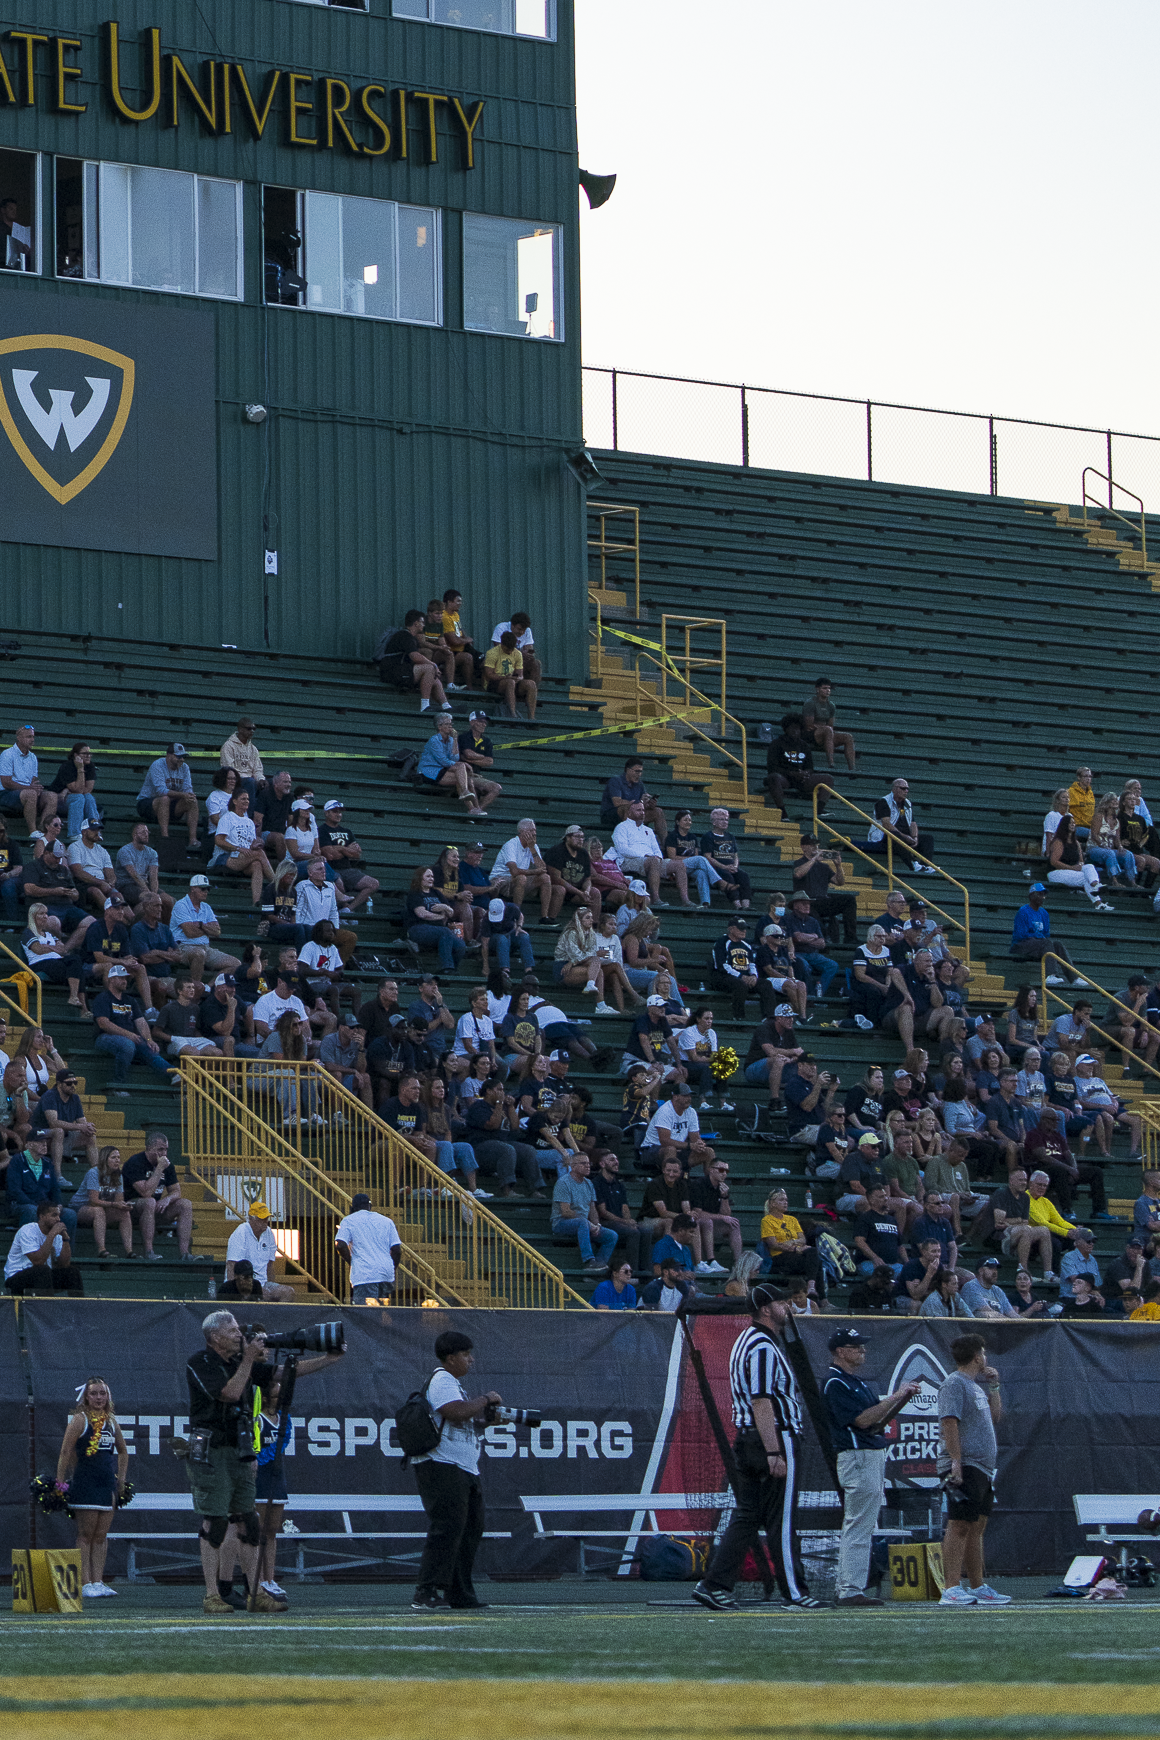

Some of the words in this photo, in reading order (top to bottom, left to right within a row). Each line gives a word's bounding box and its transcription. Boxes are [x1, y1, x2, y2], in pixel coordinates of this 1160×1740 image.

[103, 20, 485, 170] UNIVERSITY
[908, 1393, 938, 1405] amazo
[899, 1422, 940, 1442] PRE
[885, 1441, 940, 1462] KICK
[893, 1555, 918, 1588] 30
